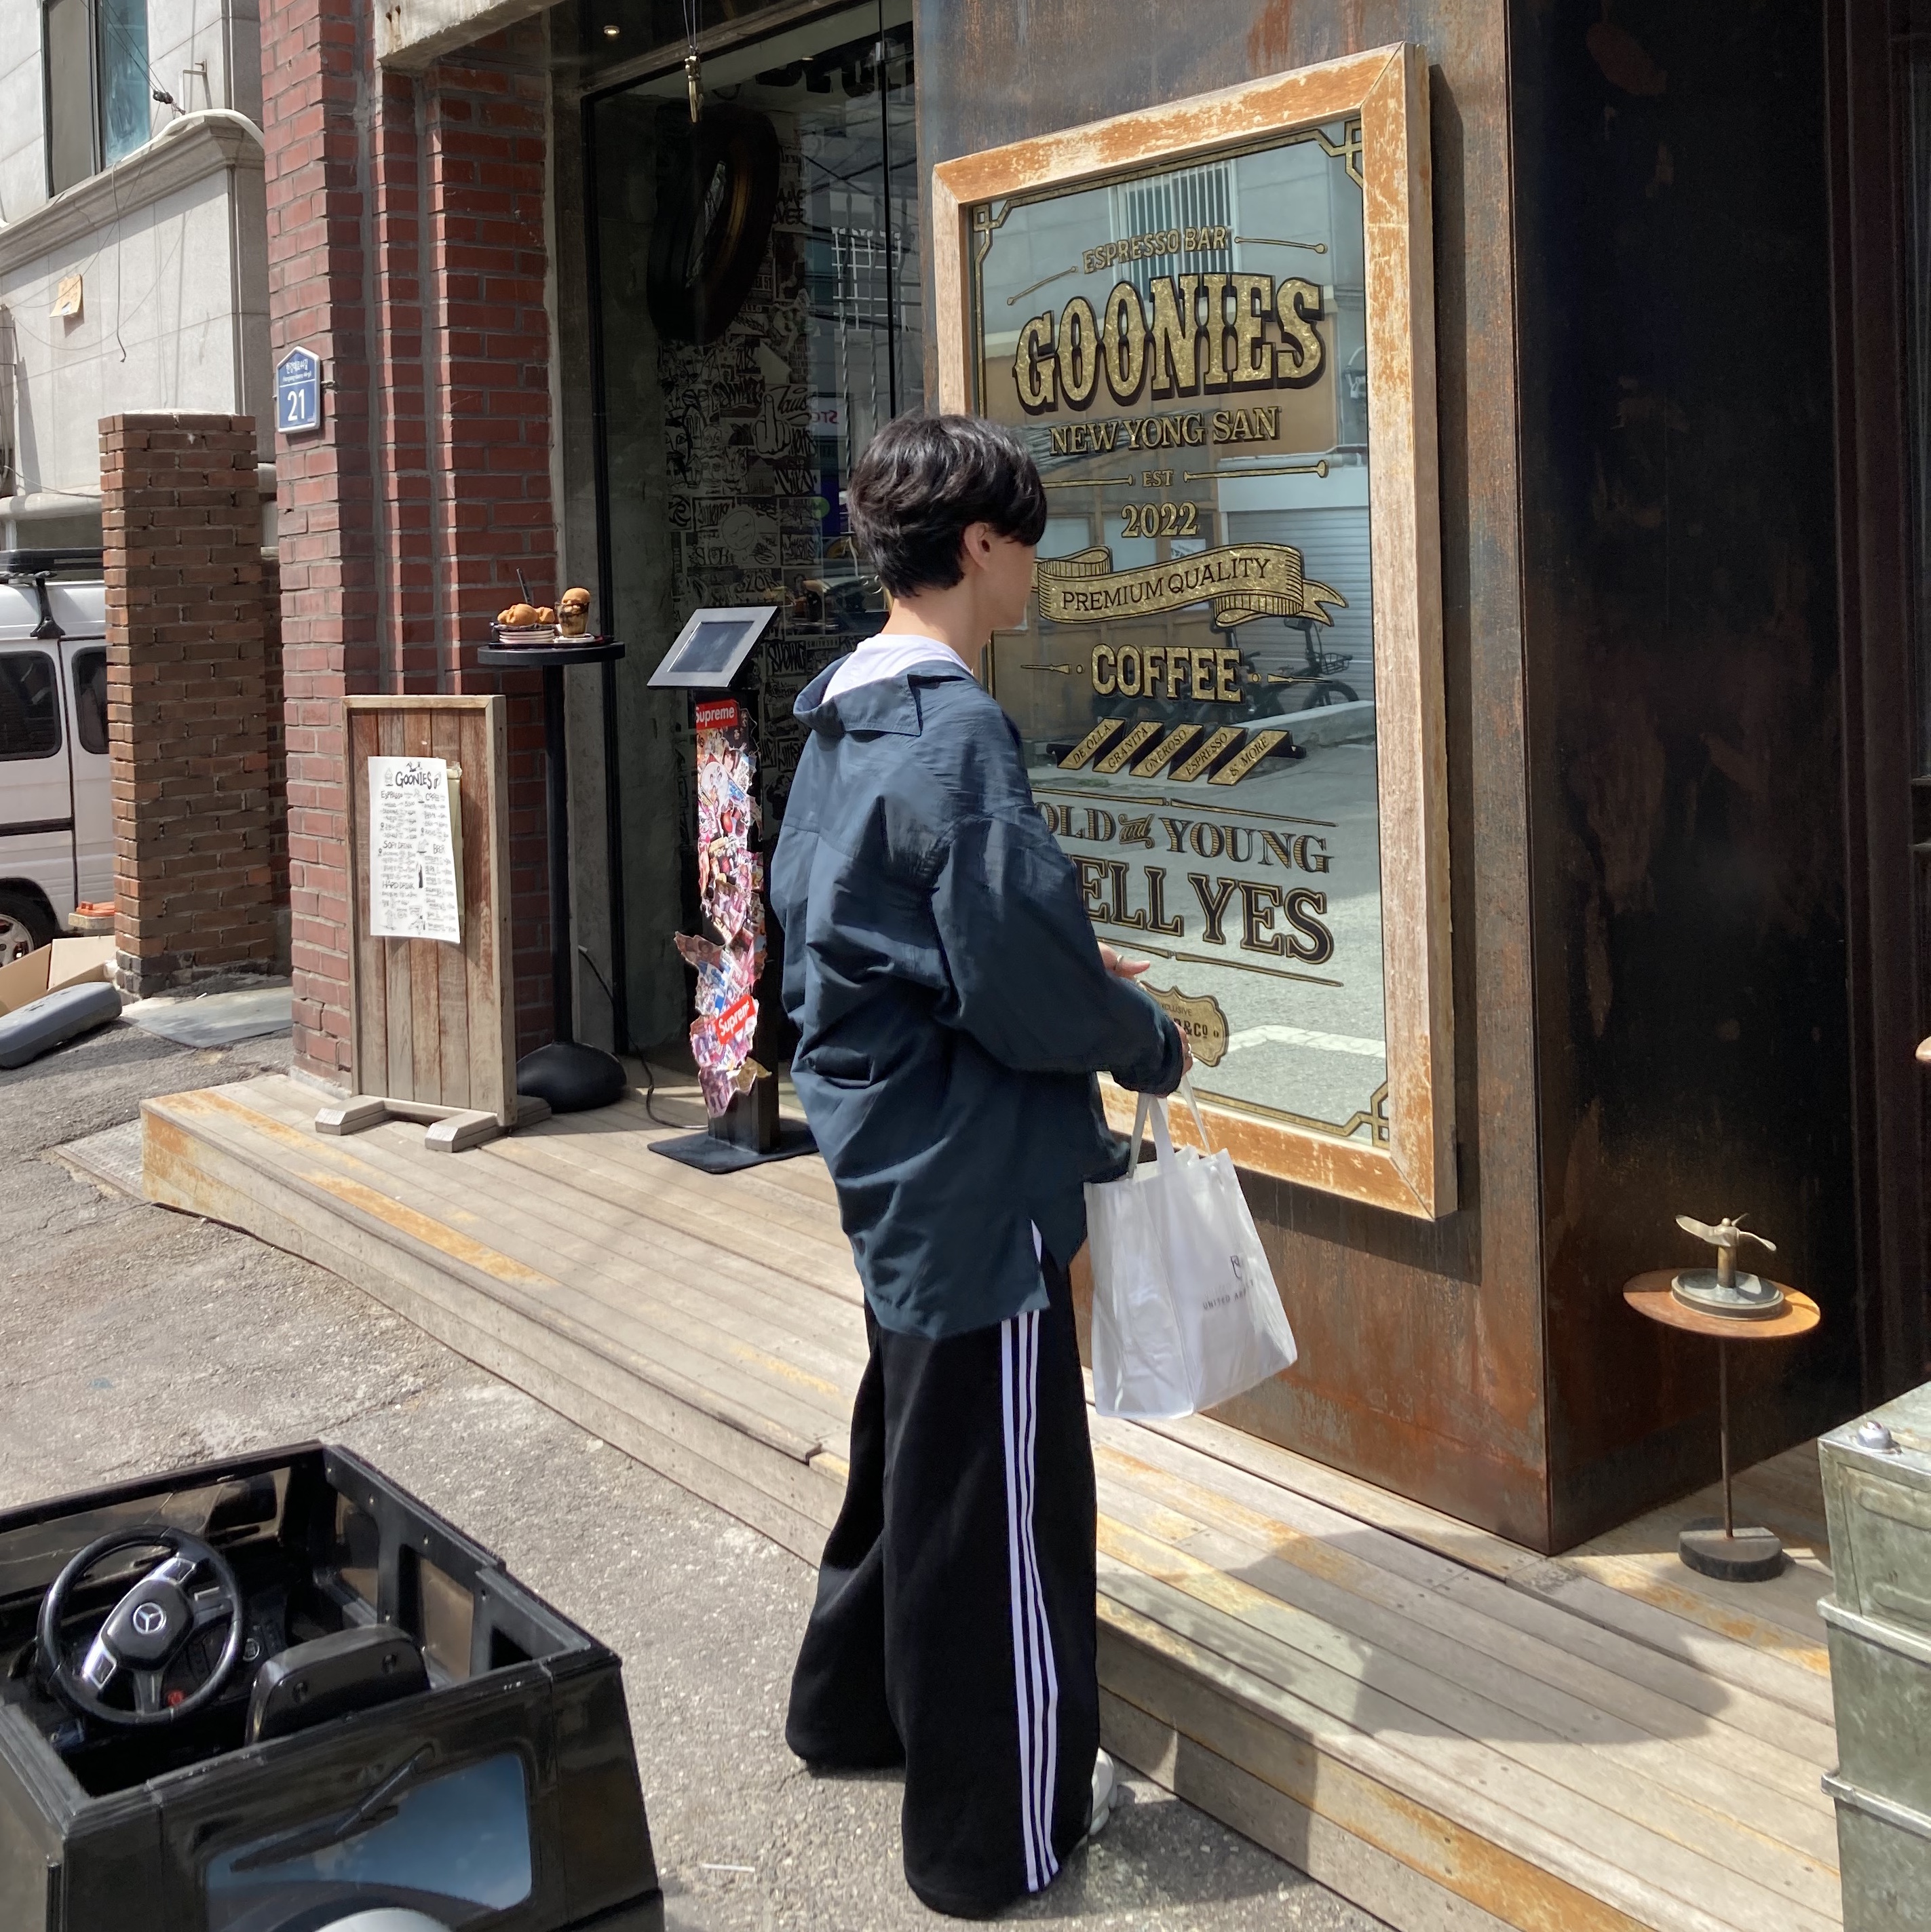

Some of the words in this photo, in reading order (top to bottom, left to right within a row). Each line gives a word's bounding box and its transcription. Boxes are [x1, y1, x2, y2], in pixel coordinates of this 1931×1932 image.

[1082, 229, 1180, 274] ESPRESSO
[1185, 225, 1230, 251] BAR
[1012, 272, 1326, 415] GOONIES
[287, 389, 305, 421] 21
[1048, 421, 1119, 455] NEW
[1121, 412, 1206, 450] YONG
[1212, 406, 1281, 444] SAN
[1142, 469, 1174, 487] EST
[1122, 501, 1200, 538] 2022
[1062, 577, 1164, 611] PREMIUM
[1168, 557, 1270, 594] QUALITY
[1091, 643, 1246, 704] COFFEE
[695, 706, 735, 727] Supreme
[1073, 748, 1087, 765] DE
[1086, 724, 1111, 750] OLLA
[1108, 727, 1149, 769] GRANITA
[1145, 729, 1187, 773] ONEROSO
[1185, 733, 1227, 775] ESPRESSO
[1240, 737, 1269, 766] MORE
[396, 771, 432, 790] GOONIES
[1034, 802, 1116, 841] OLD
[1118, 813, 1155, 848] and
[1158, 817, 1334, 873] YOUNG
[1065, 852, 1184, 938] ELL
[1187, 872, 1334, 965] YES
[719, 1000, 750, 1037] Suprem
[1161, 1003, 1192, 1016] XCLUSIVE
[1202, 1294, 1231, 1311] UNITED
